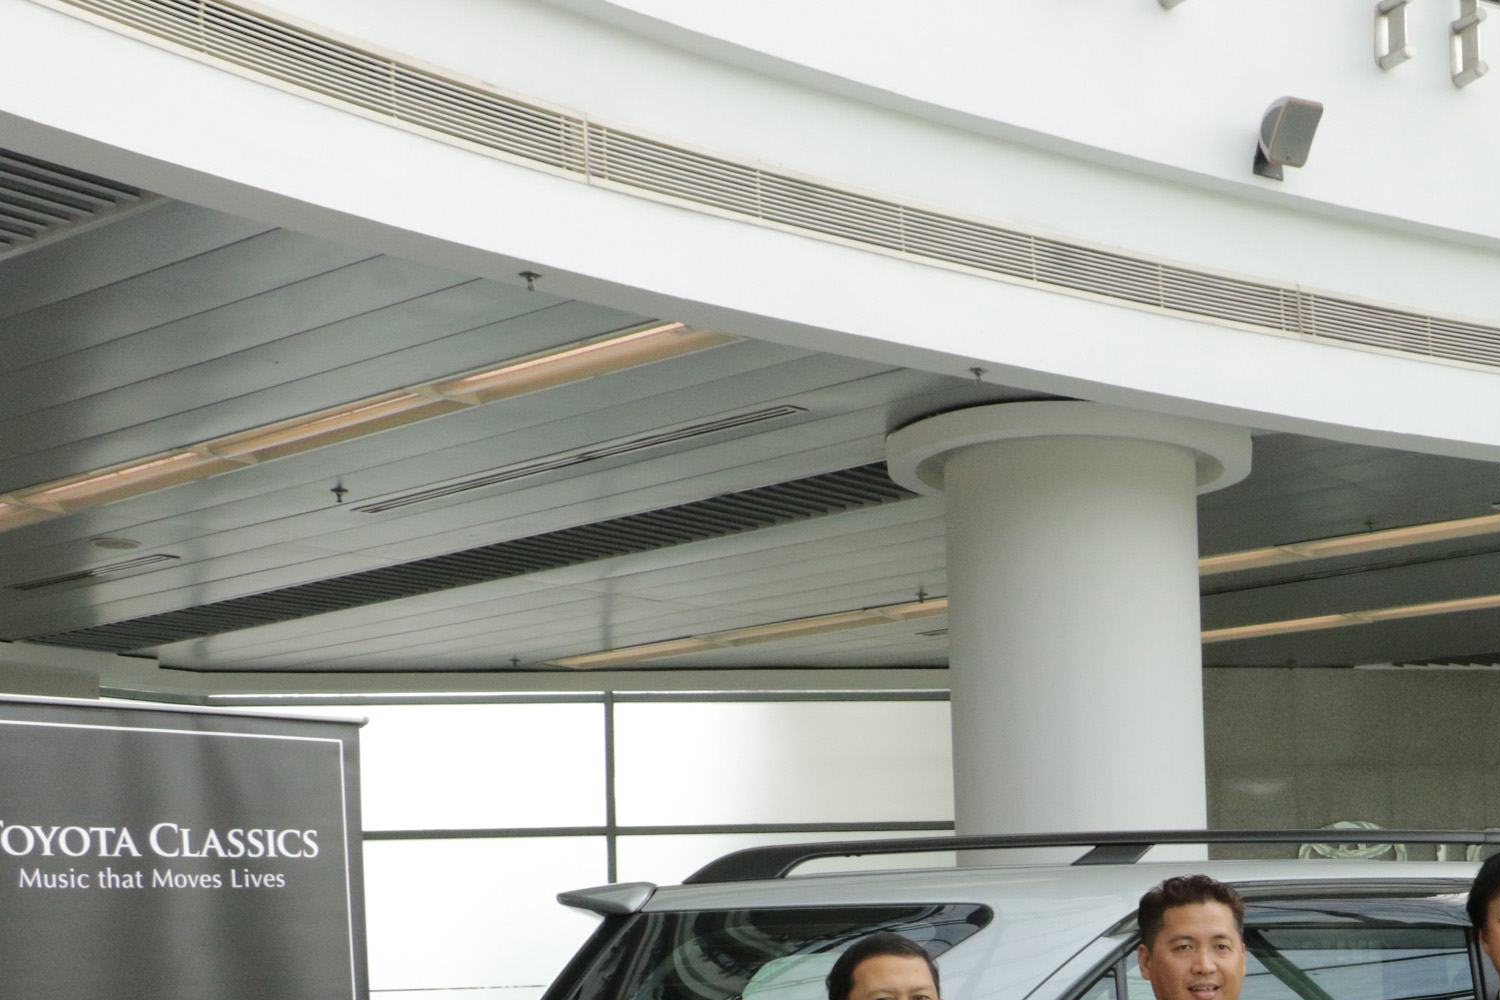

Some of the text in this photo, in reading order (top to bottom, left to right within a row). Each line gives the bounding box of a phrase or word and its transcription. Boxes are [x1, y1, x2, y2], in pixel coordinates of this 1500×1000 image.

[0, 819, 319, 858] OYOTA CLASSICS
[19, 866, 285, 889] Music that Moves Lives
